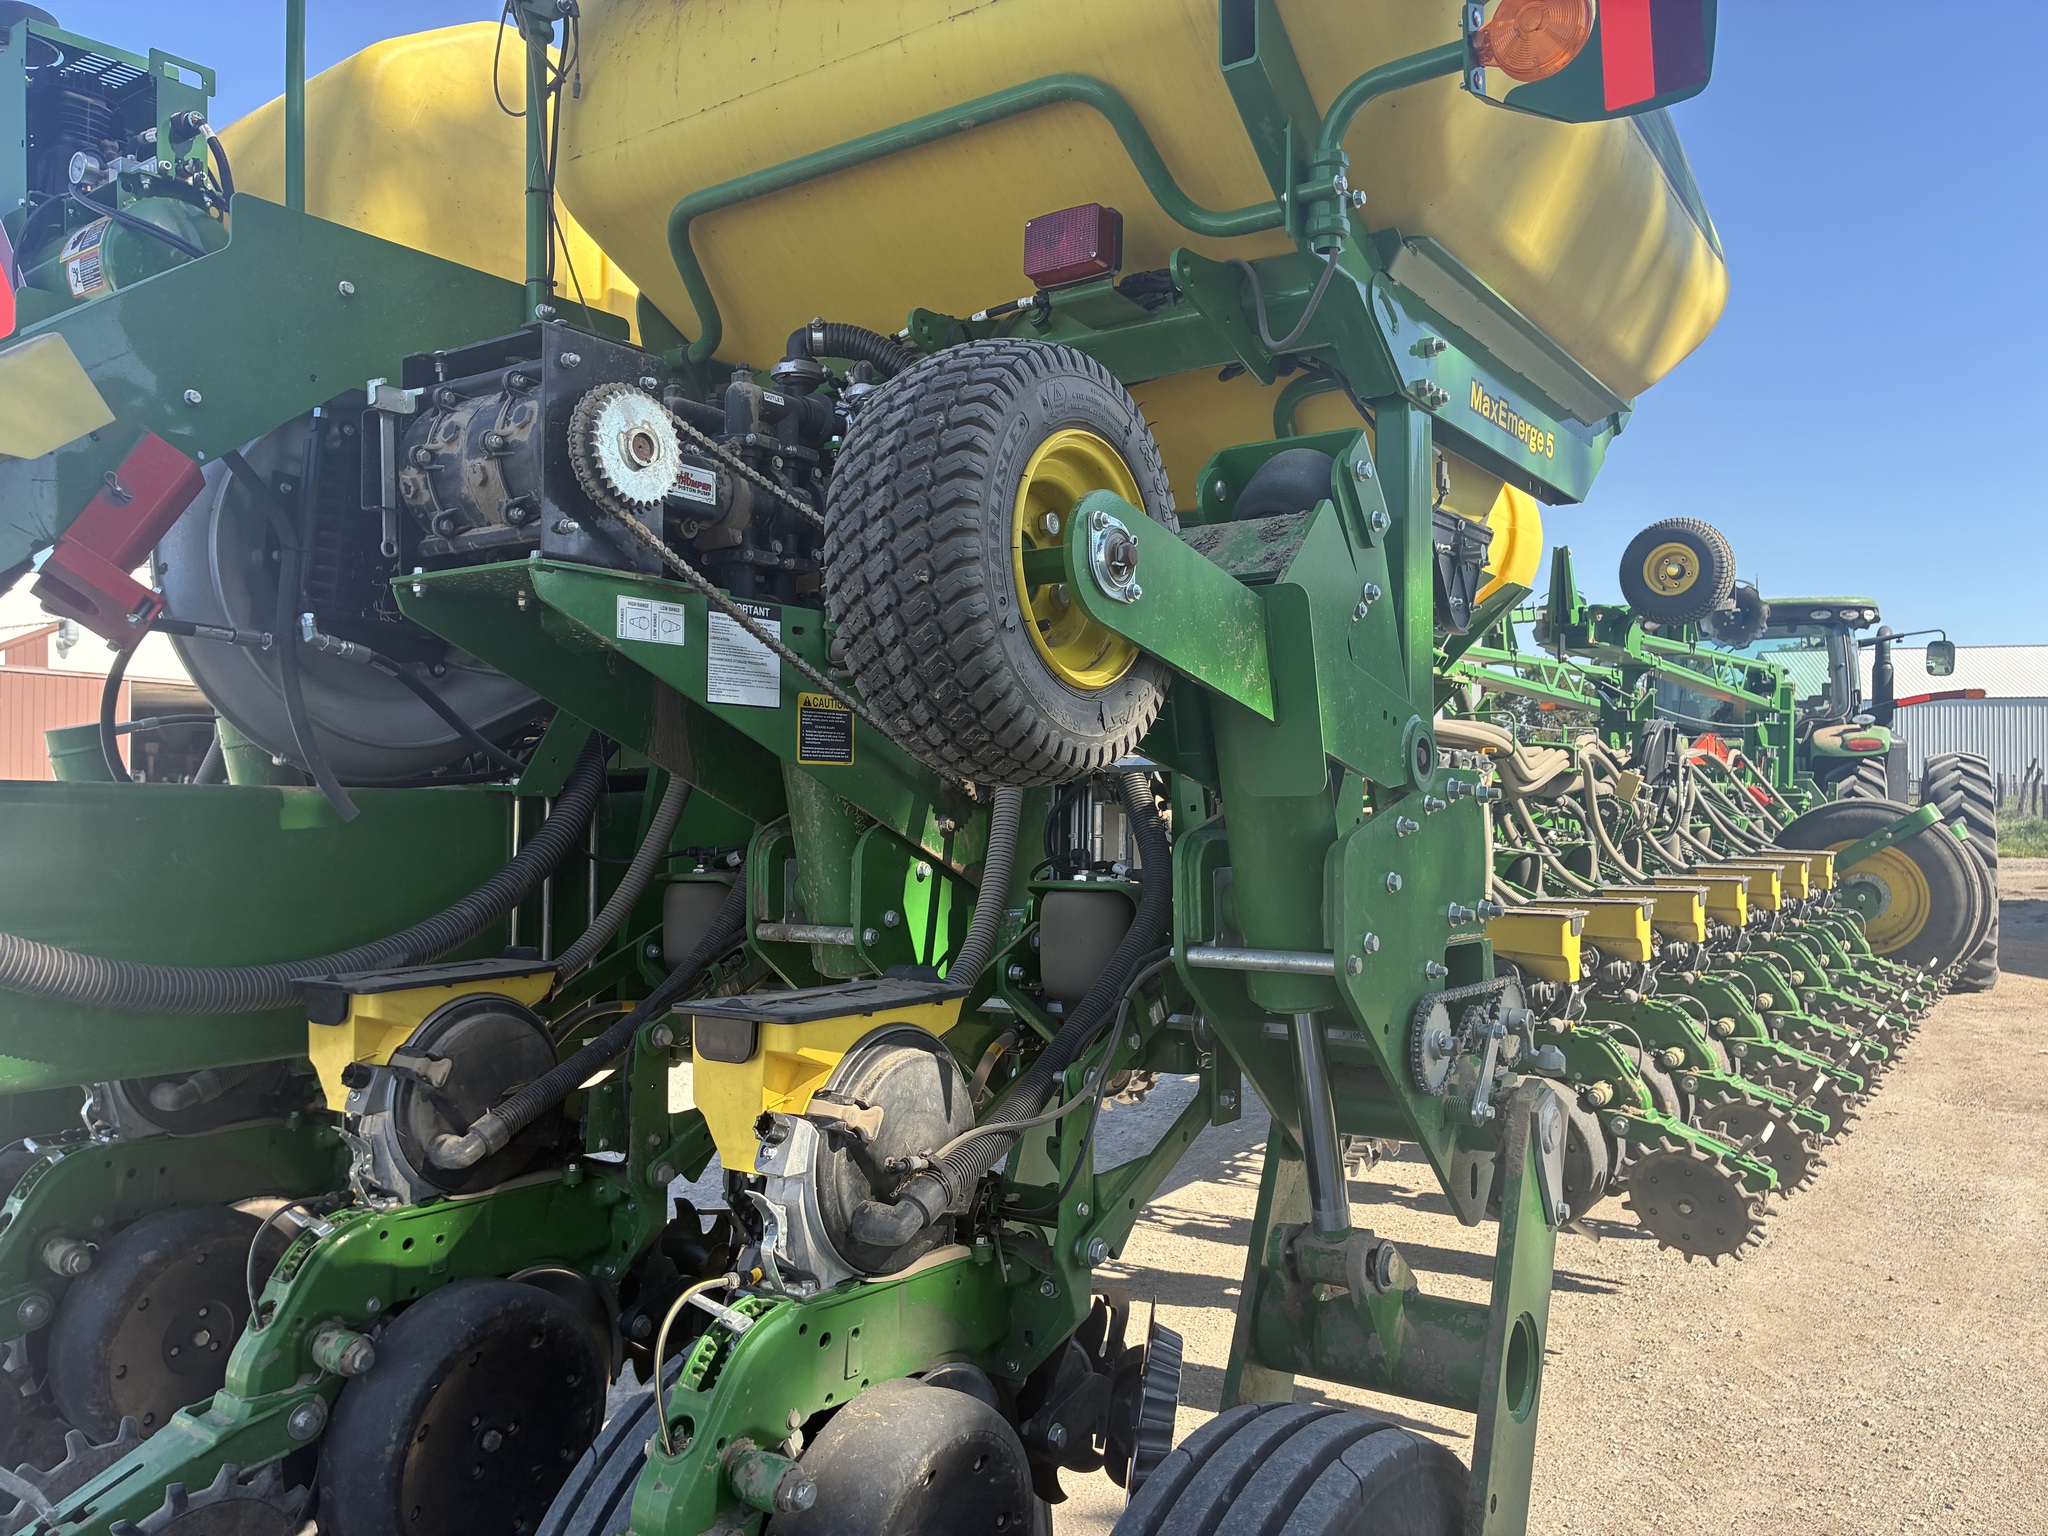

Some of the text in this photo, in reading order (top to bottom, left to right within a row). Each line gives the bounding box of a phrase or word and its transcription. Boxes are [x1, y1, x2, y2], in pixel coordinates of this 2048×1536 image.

[765, 393, 783, 403] OUTLET
[1470, 378, 1556, 460] MaxEmerge 5
[678, 485, 696, 494] PISTON
[989, 428, 1021, 594] CARLISLE
